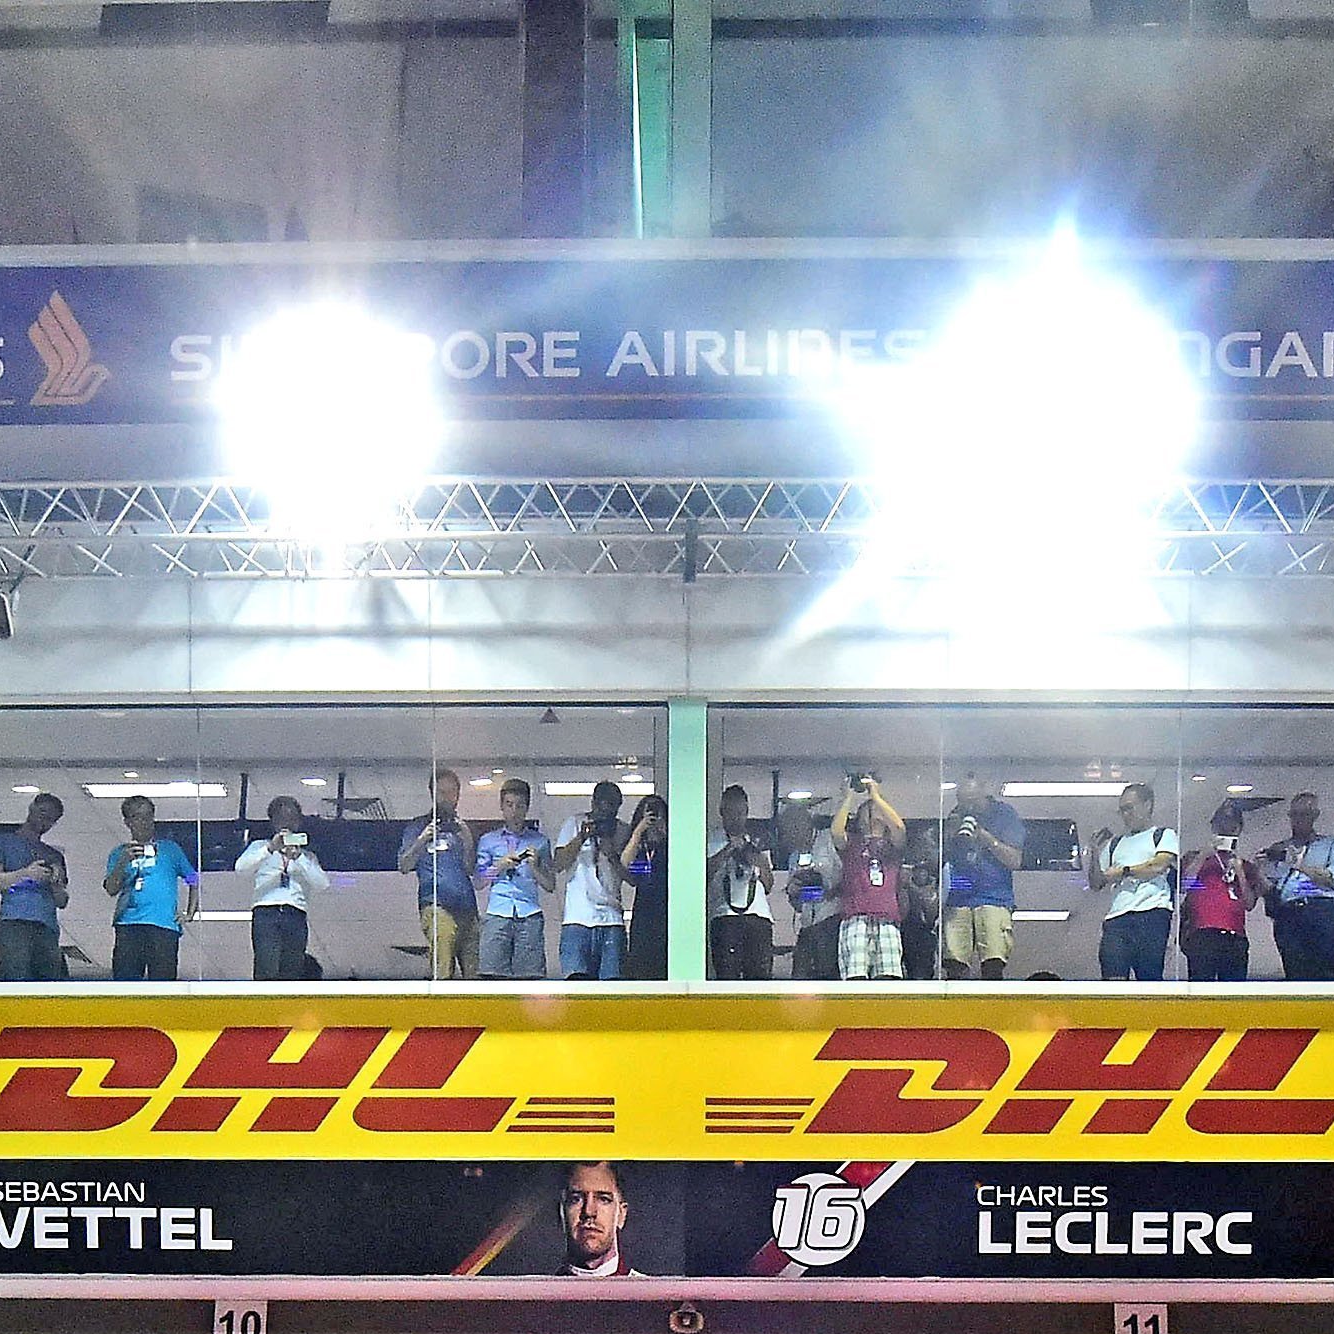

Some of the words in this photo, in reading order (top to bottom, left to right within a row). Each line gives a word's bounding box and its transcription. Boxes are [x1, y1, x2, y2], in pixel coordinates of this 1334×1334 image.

[977, 1186, 1108, 1207] CHARLES
[772, 1185, 864, 1250] 16
[978, 1211, 1253, 1255] LECLERC
